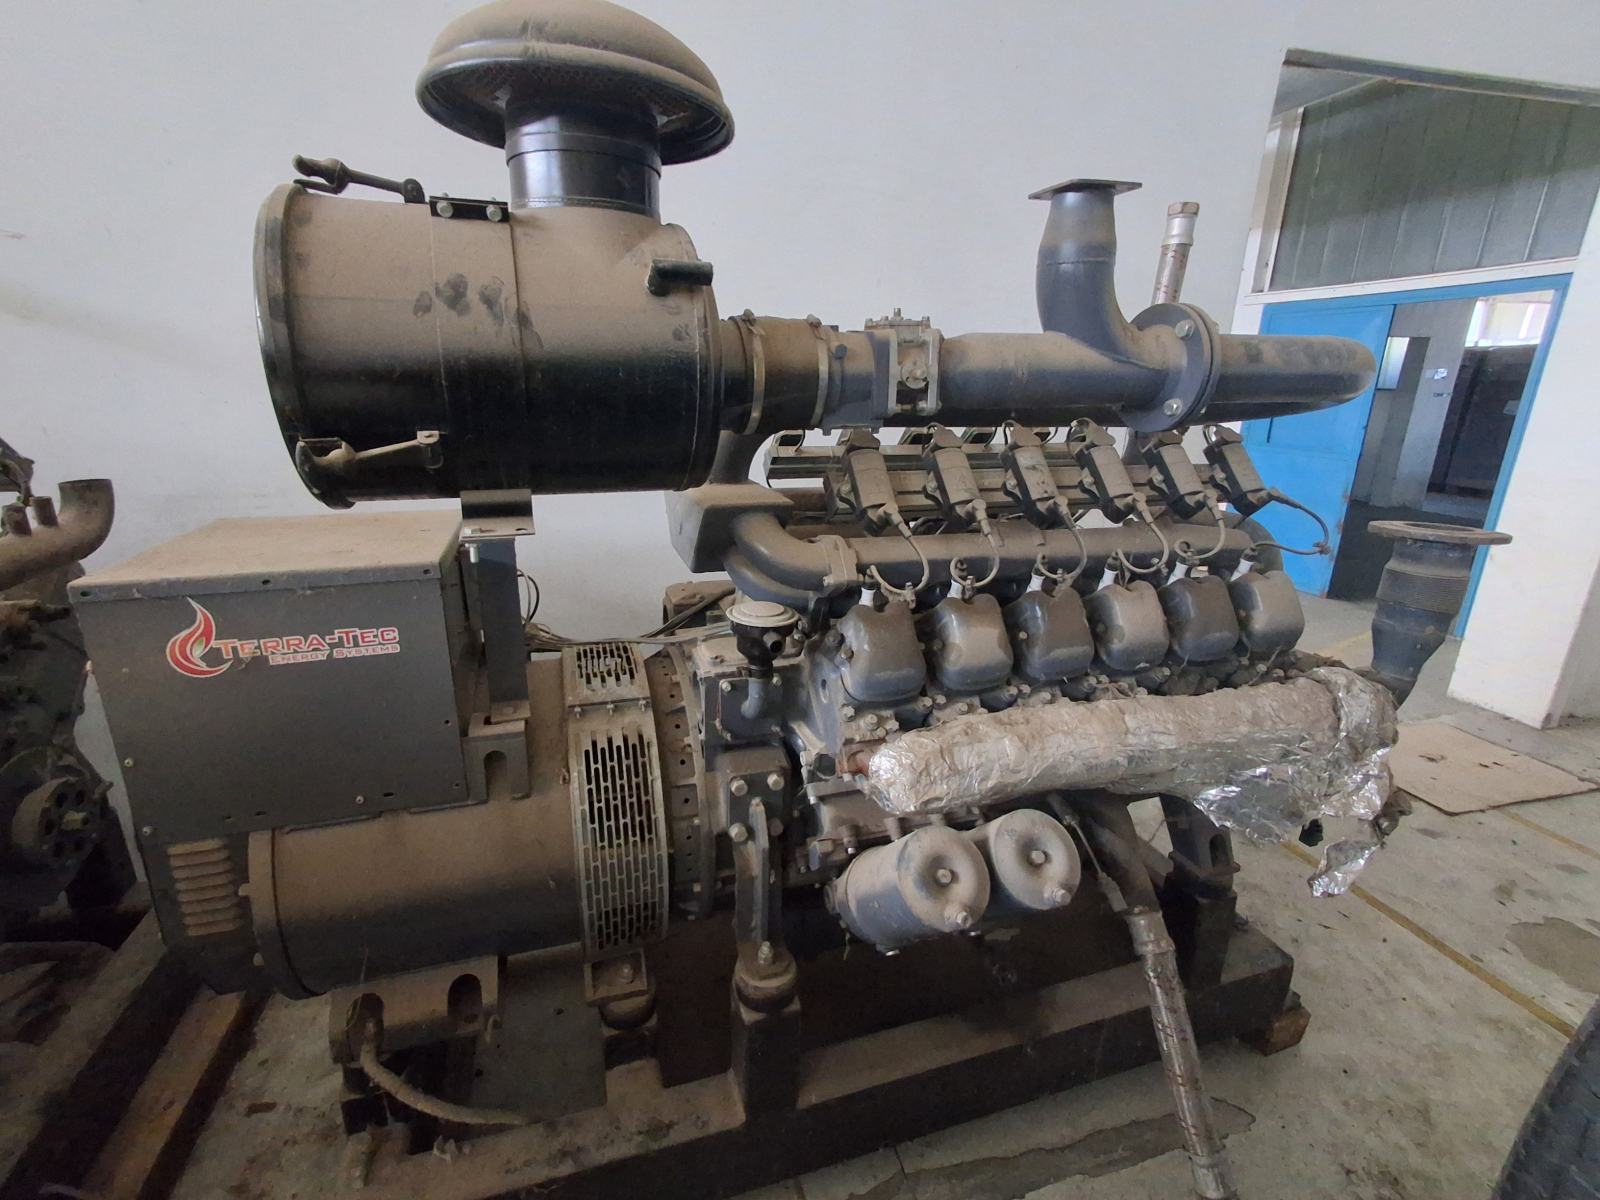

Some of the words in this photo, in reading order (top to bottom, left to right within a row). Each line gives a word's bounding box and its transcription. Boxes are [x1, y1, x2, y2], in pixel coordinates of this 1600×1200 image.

[214, 628, 399, 658] TERRA-TEC
[269, 651, 328, 665] ENERGY
[333, 644, 400, 658] SYSTEMS
